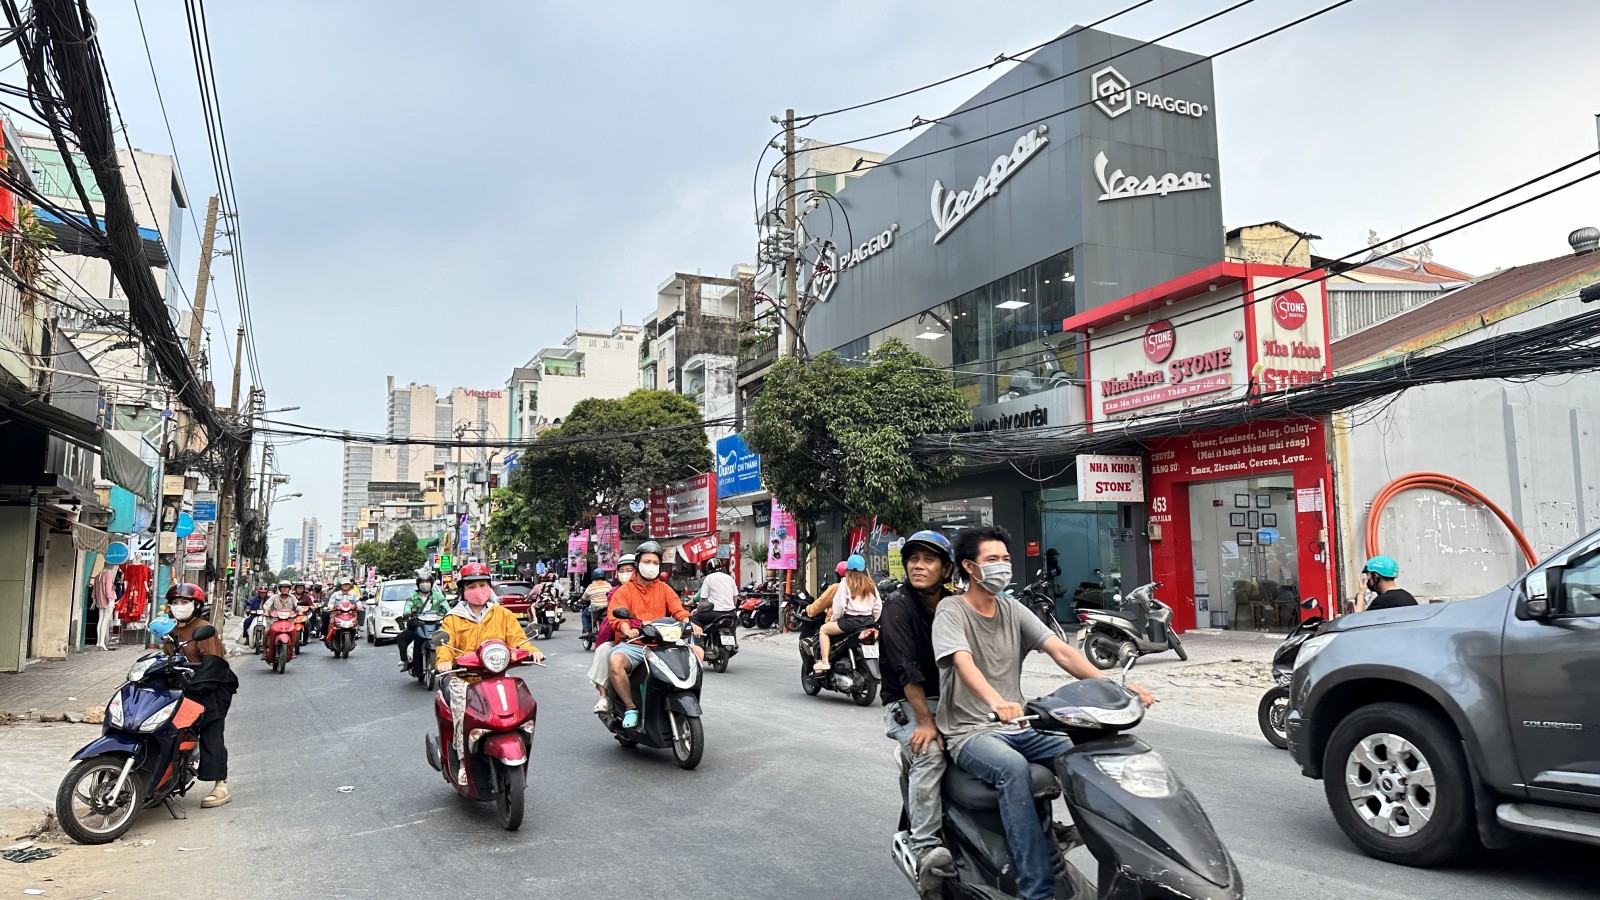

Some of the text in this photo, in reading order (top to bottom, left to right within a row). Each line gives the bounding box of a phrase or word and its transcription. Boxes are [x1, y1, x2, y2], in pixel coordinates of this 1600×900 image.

[1135, 90, 1203, 117] PIAGGIO
[1093, 150, 1212, 201] Vespa
[929, 129, 1049, 244] Vespa
[839, 229, 893, 271] PIAGGIO
[1279, 301, 1306, 319] STONE
[1148, 329, 1172, 355] STONE
[1263, 340, 1321, 358] Nha khoa
[1101, 347, 1232, 397] Nhakhoa STONE
[1258, 428, 1282, 440] Inlay,
[1089, 463, 1136, 474] NHA KHOA
[1191, 455, 1313, 475] Emax, Zirconia, Cercon, Lava...
[1095, 481, 1132, 494] STONE
[1152, 496, 1167, 513] 453
[1522, 720, 1583, 731] COLORADO
